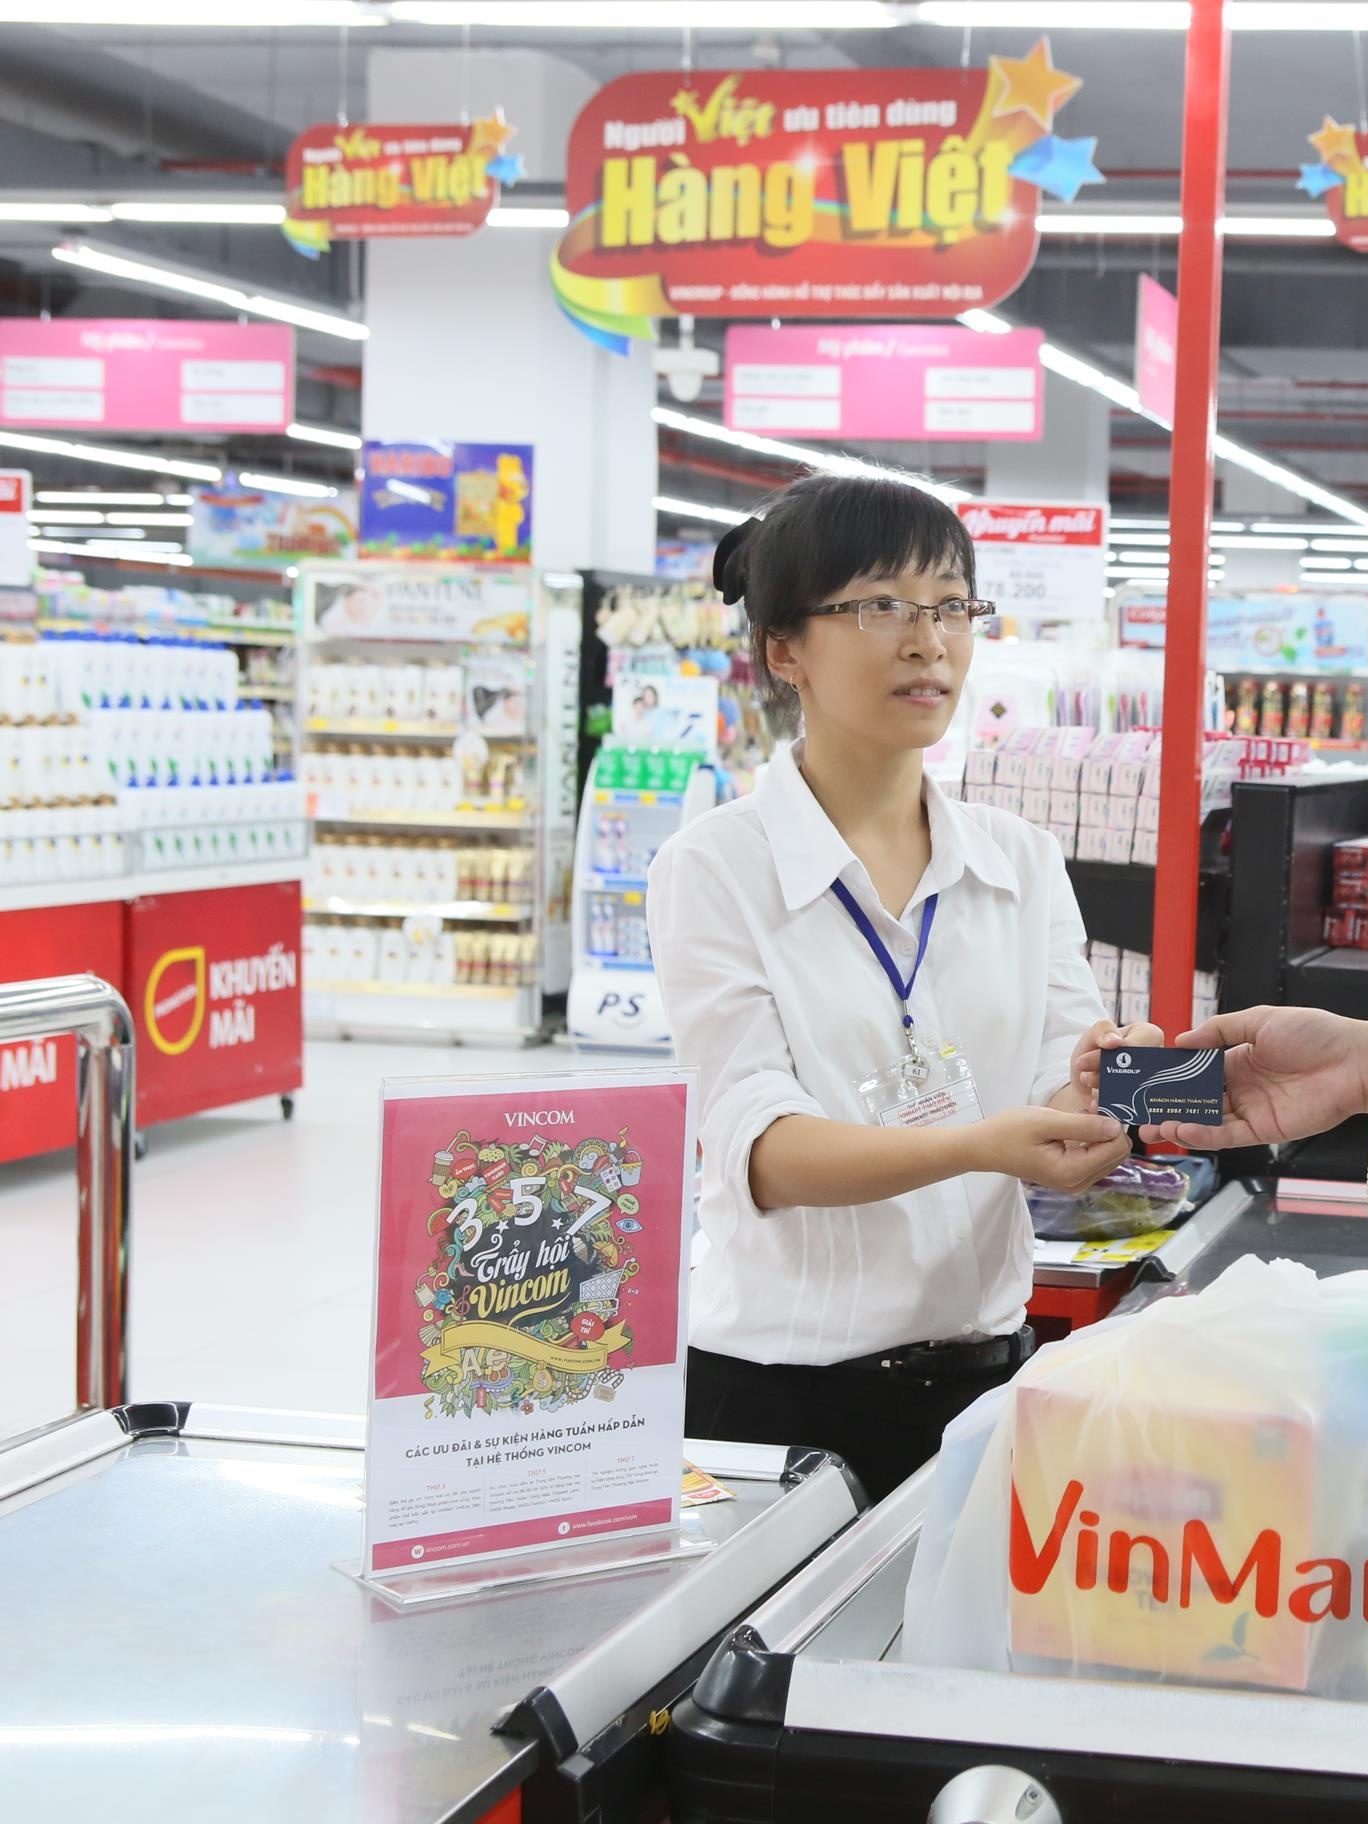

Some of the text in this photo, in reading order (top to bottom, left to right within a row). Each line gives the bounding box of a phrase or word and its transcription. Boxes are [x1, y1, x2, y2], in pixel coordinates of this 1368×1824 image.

[603, 116, 686, 150] Người
[671, 72, 775, 147] Việt
[886, 98, 957, 127] dùng
[303, 153, 488, 209] Hàng Việt
[601, 136, 1014, 247] Hàng Việt
[209, 942, 296, 1000] KHUYẾN
[209, 999, 256, 1049] MÃI
[504, 1110, 576, 1127] VINCOM
[446, 1176, 612, 1252] 3 5 7
[471, 1233, 570, 1283] Trẩy hội
[469, 1267, 570, 1319] Vincom
[405, 1414, 645, 1459] CÁC ƯU ĐÃI & SỰ KIỆN HÀNG TUẦN HẤP DẪN
[466, 1442, 591, 1470] TẠI HỆ THỐNG VINCOM
